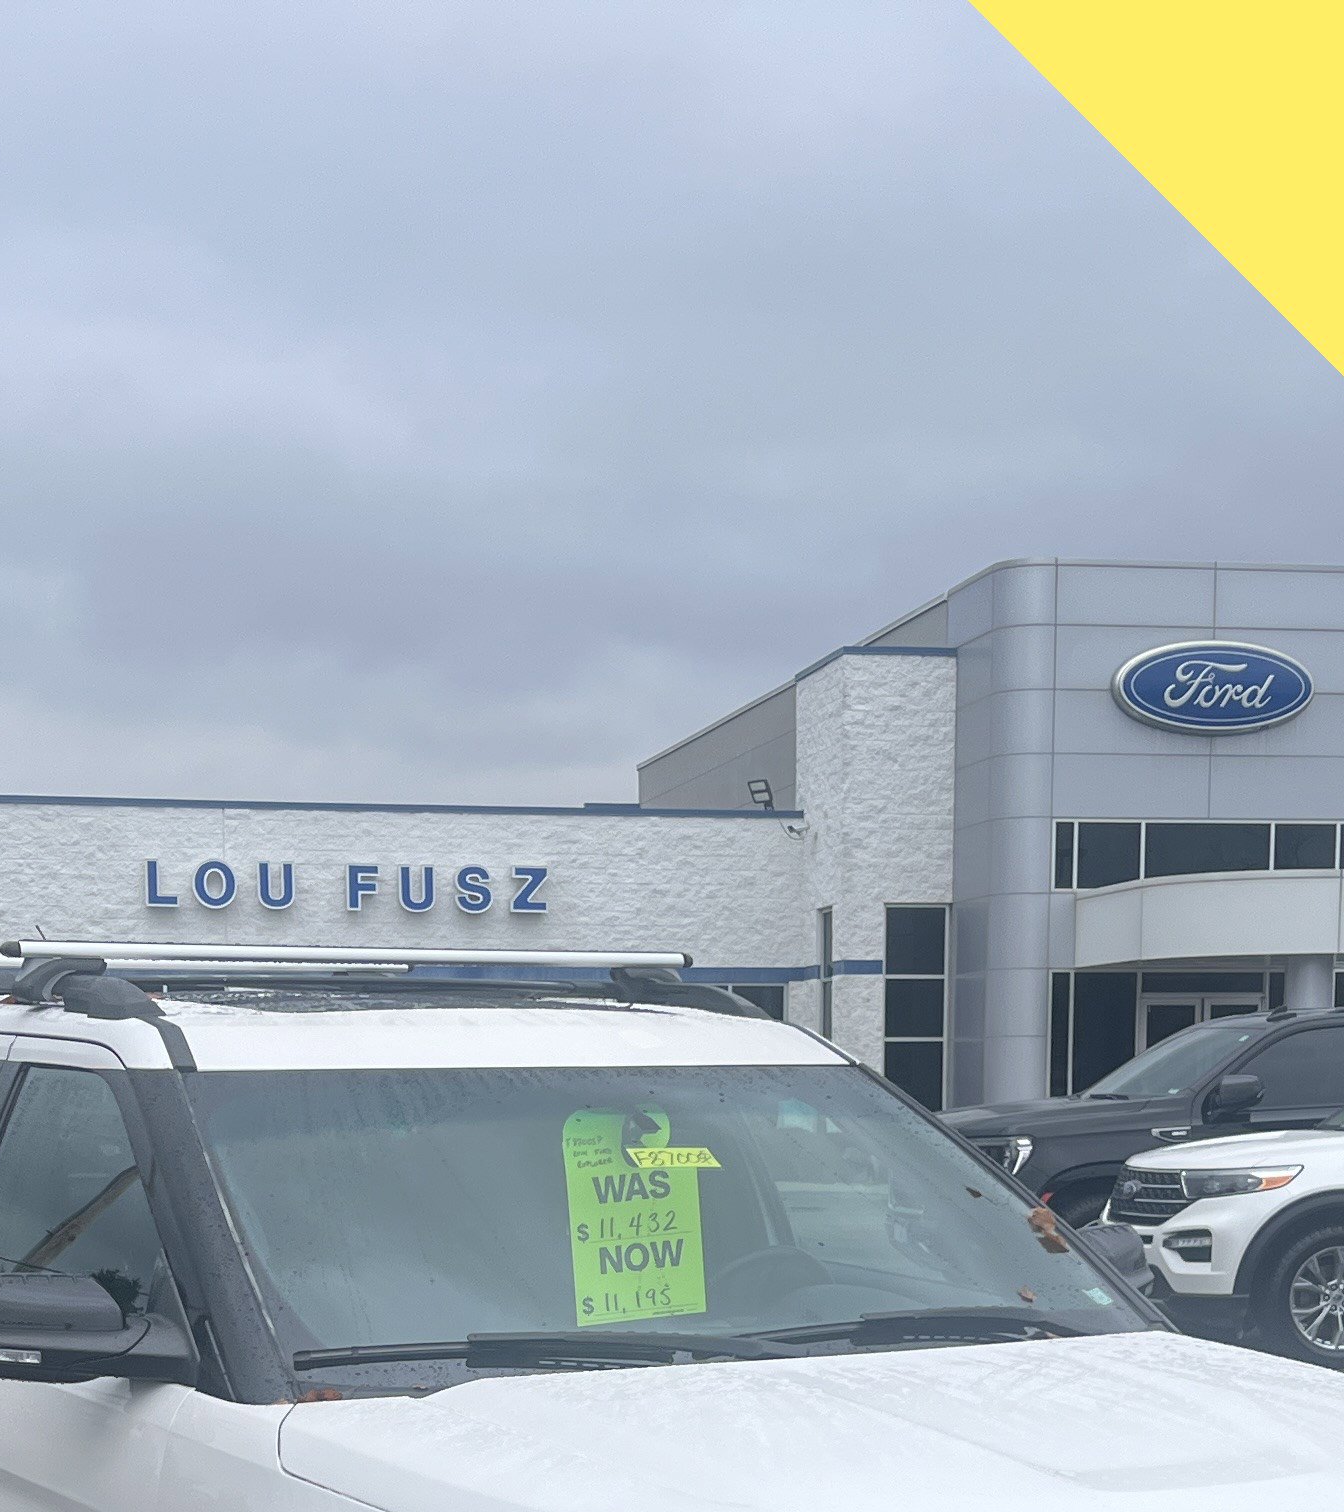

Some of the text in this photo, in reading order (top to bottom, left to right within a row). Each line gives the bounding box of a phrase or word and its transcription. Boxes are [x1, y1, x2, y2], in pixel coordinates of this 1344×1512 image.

[1164, 660, 1275, 709] Ford
[145, 858, 549, 915] LOU FUSZ
[592, 1170, 671, 1205] WAS
[577, 1223, 590, 1244] $
[599, 1238, 684, 1275] NOW
[582, 1296, 595, 1316] $
